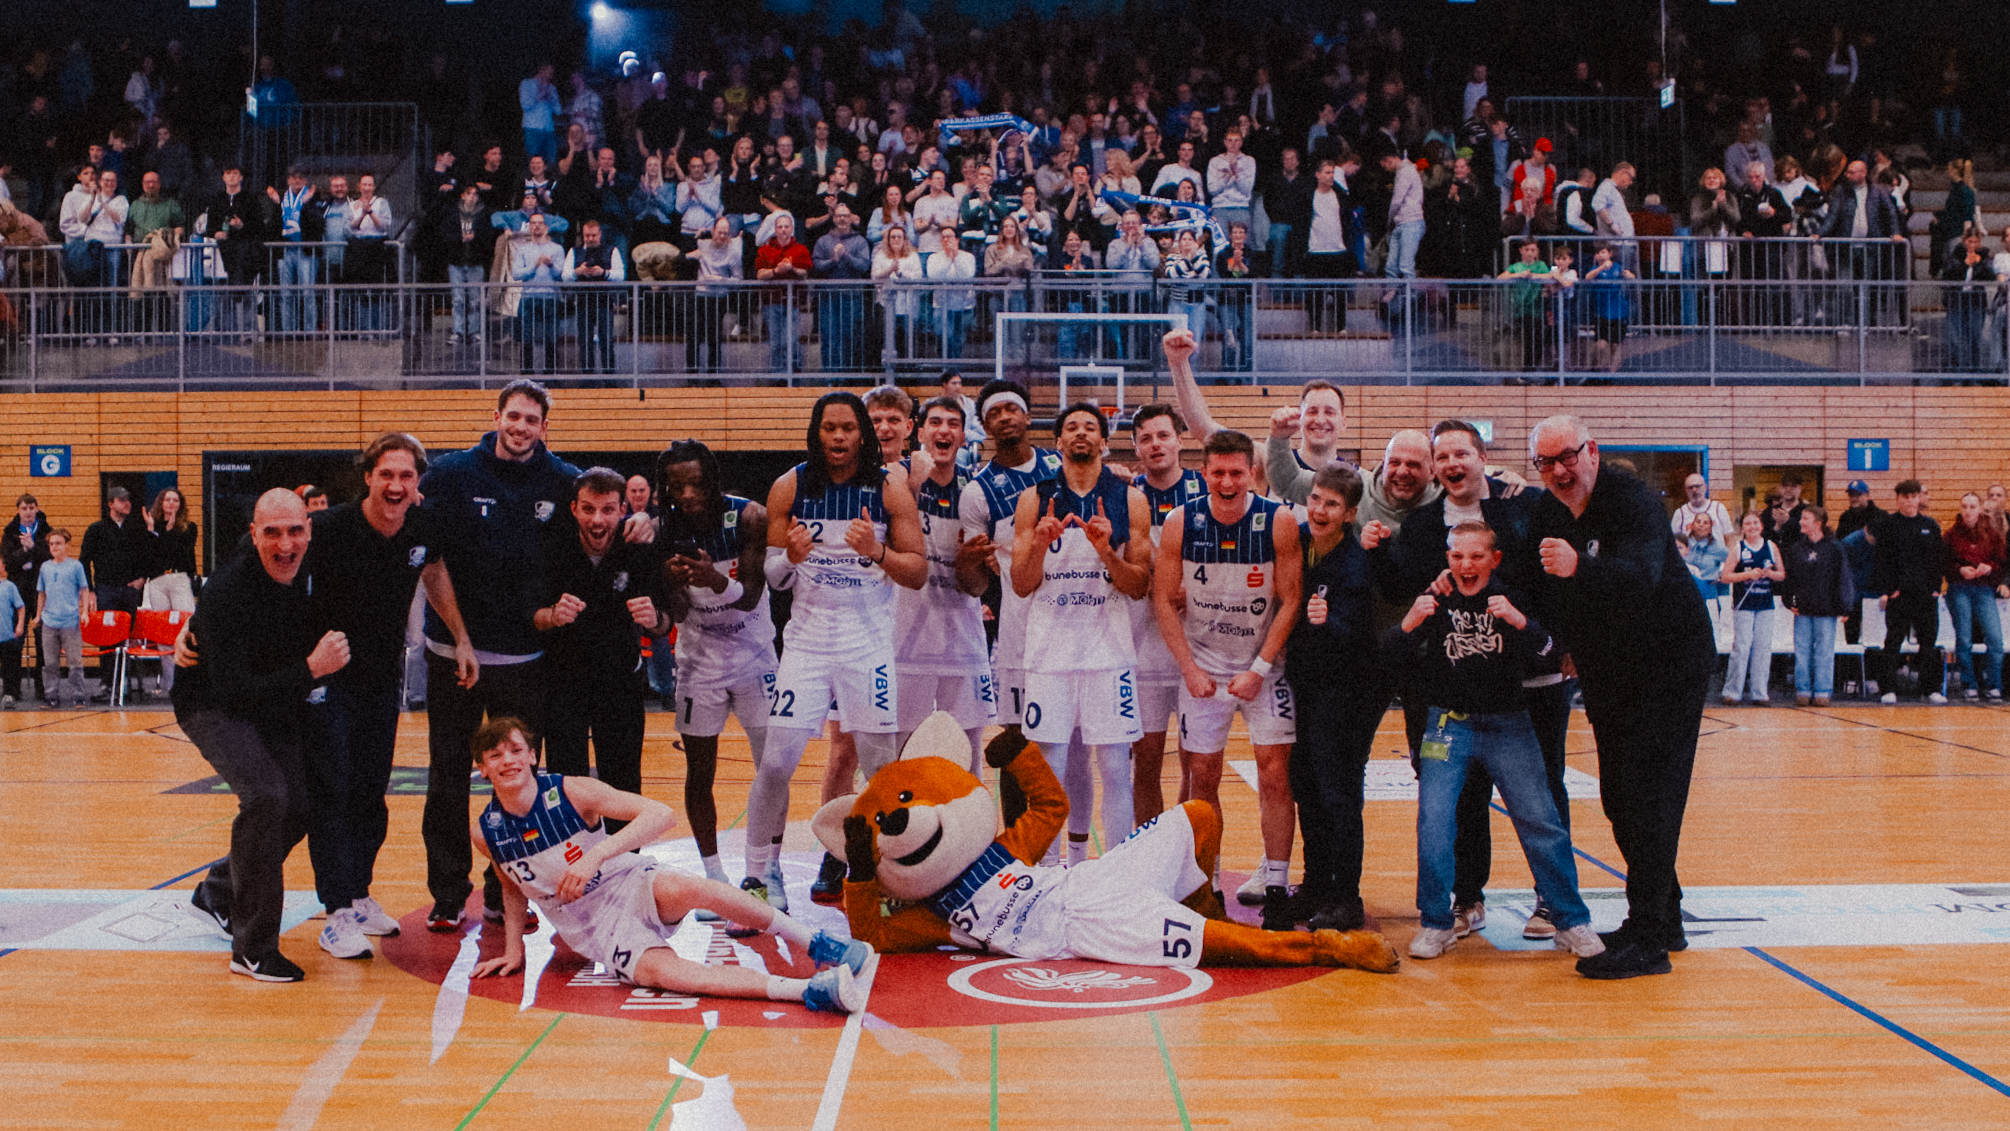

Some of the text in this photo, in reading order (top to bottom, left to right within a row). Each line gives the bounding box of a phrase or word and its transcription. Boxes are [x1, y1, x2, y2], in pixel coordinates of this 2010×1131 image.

[41, 454, 61, 476] G
[212, 463, 251, 471] REGIERAUM
[1193, 564, 1208, 586] 4
[874, 664, 890, 711] VBW
[1119, 670, 1135, 719] VBW
[1274, 676, 1293, 720] VBW
[684, 696, 694, 725] 1
[769, 689, 796, 718] 22
[1025, 702, 1042, 730] 0
[507, 860, 536, 885] 13
[951, 902, 980, 934] 57
[1162, 917, 1192, 959] 57
